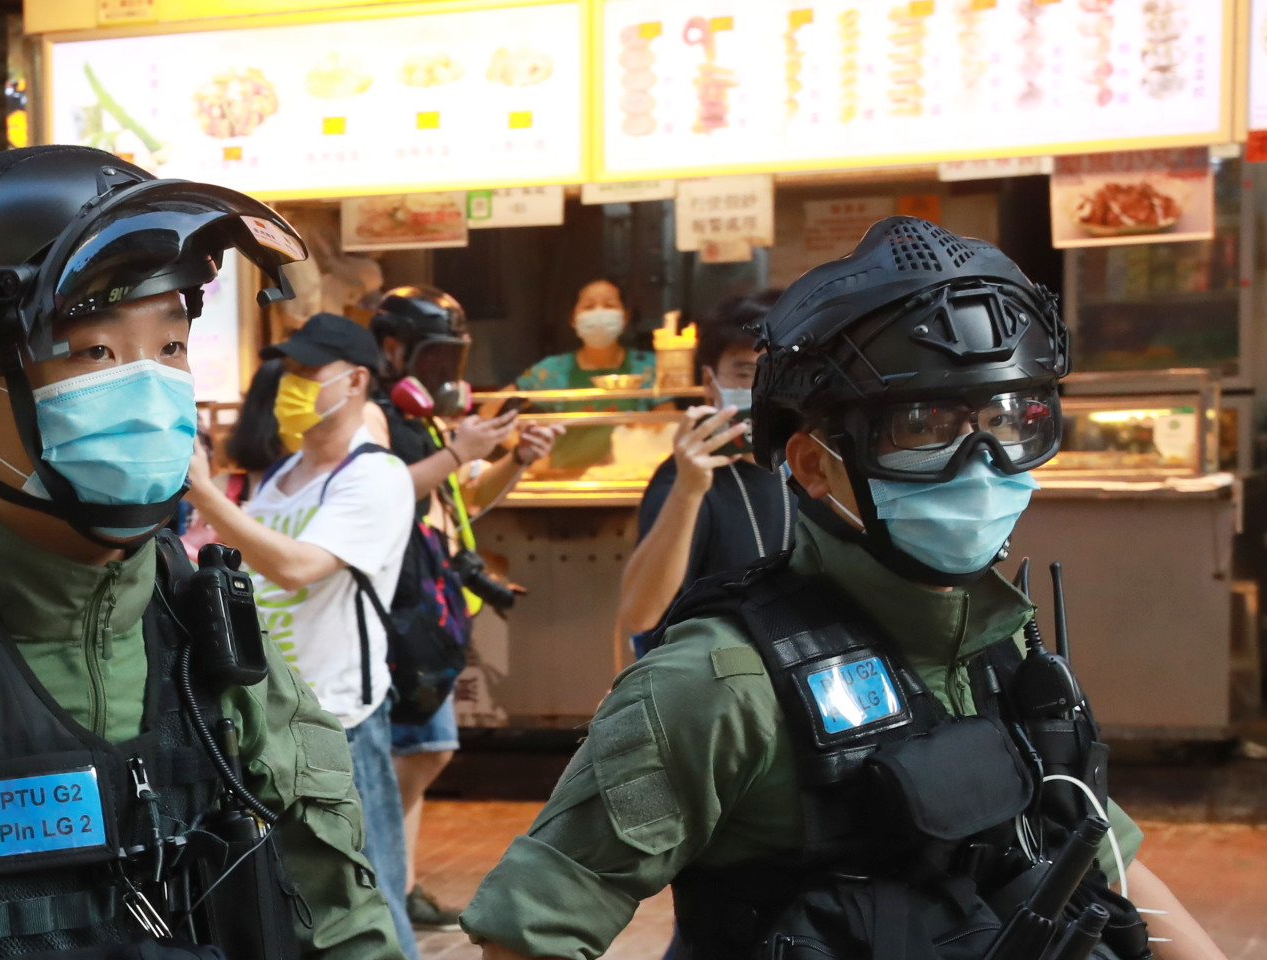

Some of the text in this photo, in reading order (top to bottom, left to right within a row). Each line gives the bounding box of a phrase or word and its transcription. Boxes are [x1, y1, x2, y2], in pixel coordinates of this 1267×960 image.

[820, 661, 878, 693] PU G2
[858, 690, 881, 710] LG
[0, 784, 83, 810] PTU G2
[41, 817, 74, 838] LG
[79, 815, 93, 834] 2
